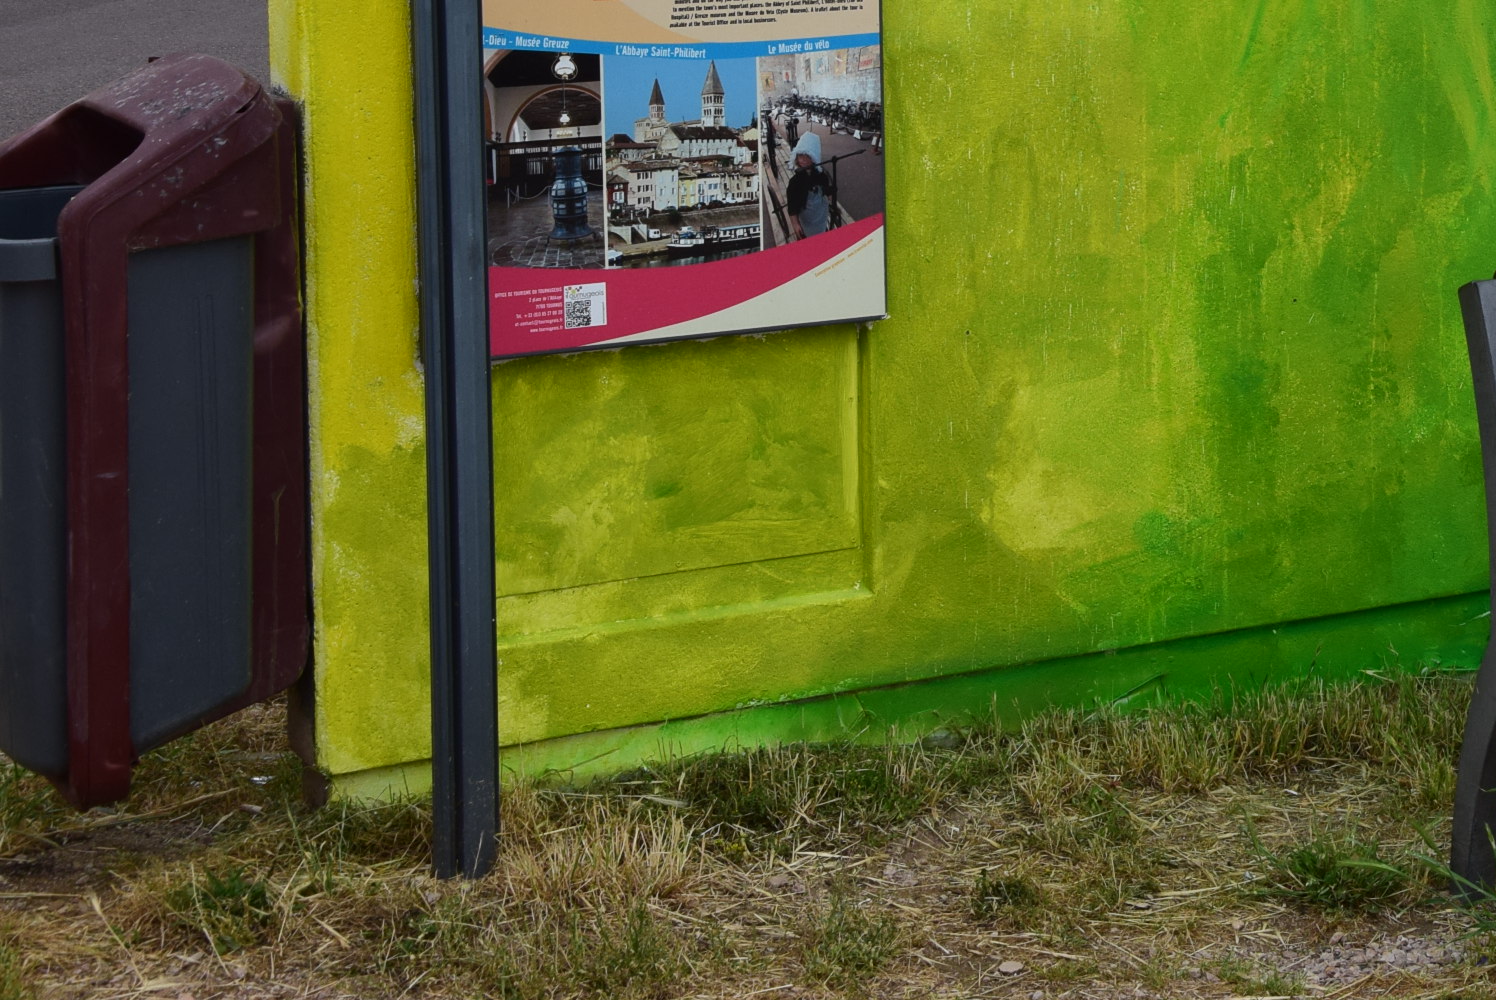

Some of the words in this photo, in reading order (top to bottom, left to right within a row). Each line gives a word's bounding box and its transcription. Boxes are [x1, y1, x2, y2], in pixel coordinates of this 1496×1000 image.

[515, 36, 541, 48] Musée
[543, 37, 570, 49] Greuze
[768, 45, 777, 55] Le
[778, 42, 802, 53] Musée
[804, 41, 813, 51] du
[814, 40, 830, 50] vélo
[615, 44, 648, 58] L'Abbaye
[650, 46, 706, 59] Saint-Philibert
